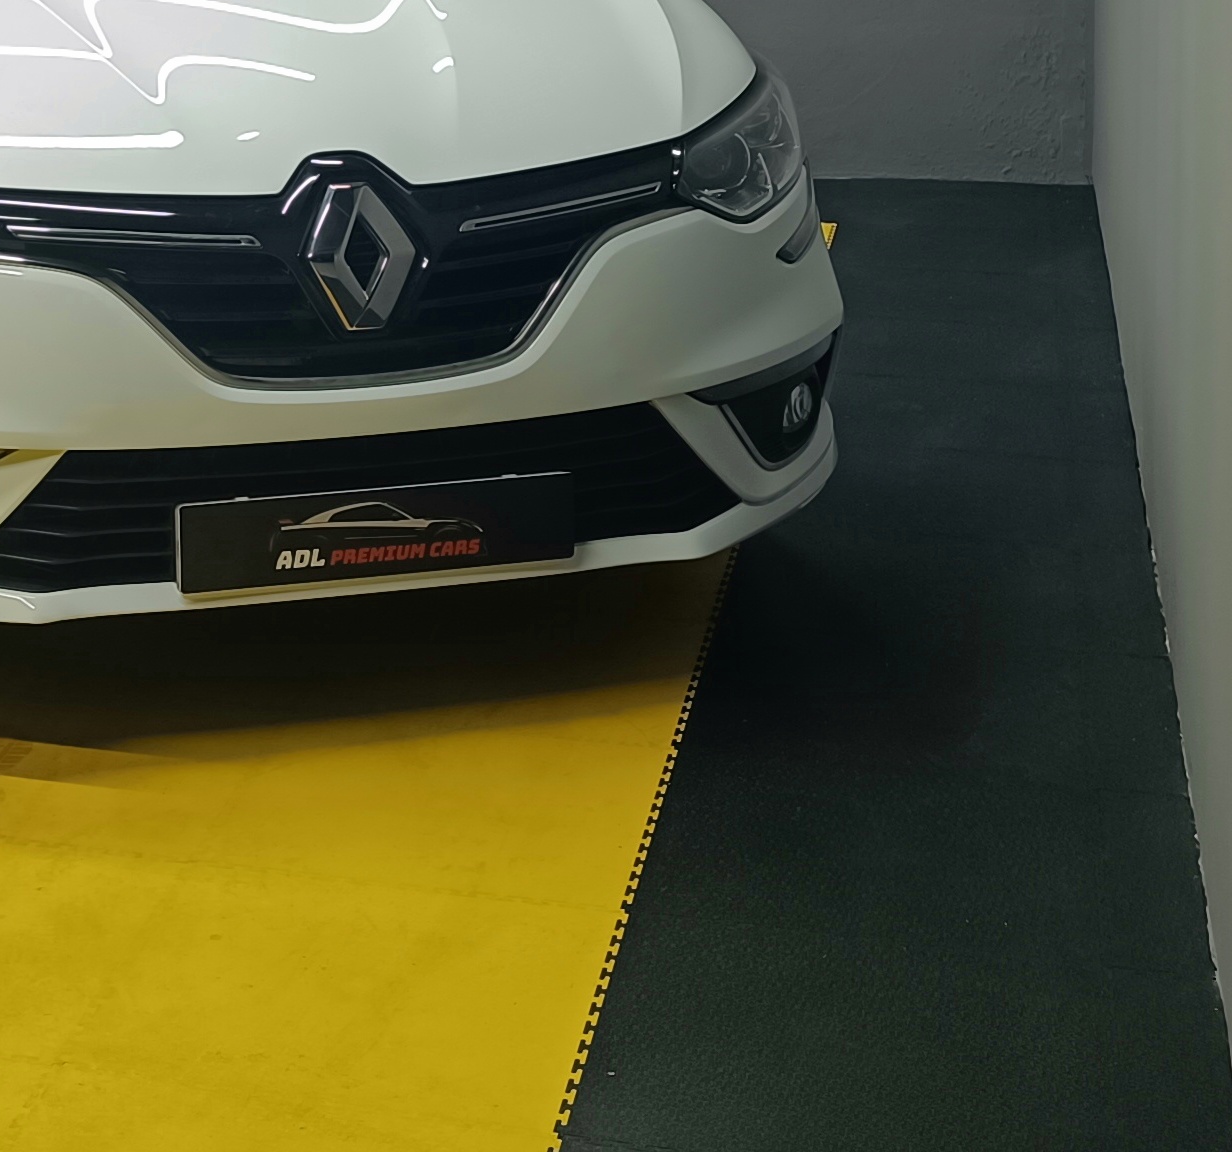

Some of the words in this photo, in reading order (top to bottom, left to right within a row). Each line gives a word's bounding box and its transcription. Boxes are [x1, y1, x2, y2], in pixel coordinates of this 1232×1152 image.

[275, 548, 325, 570] ADL
[330, 543, 426, 565] PREMIUM
[429, 538, 481, 557] CARS
